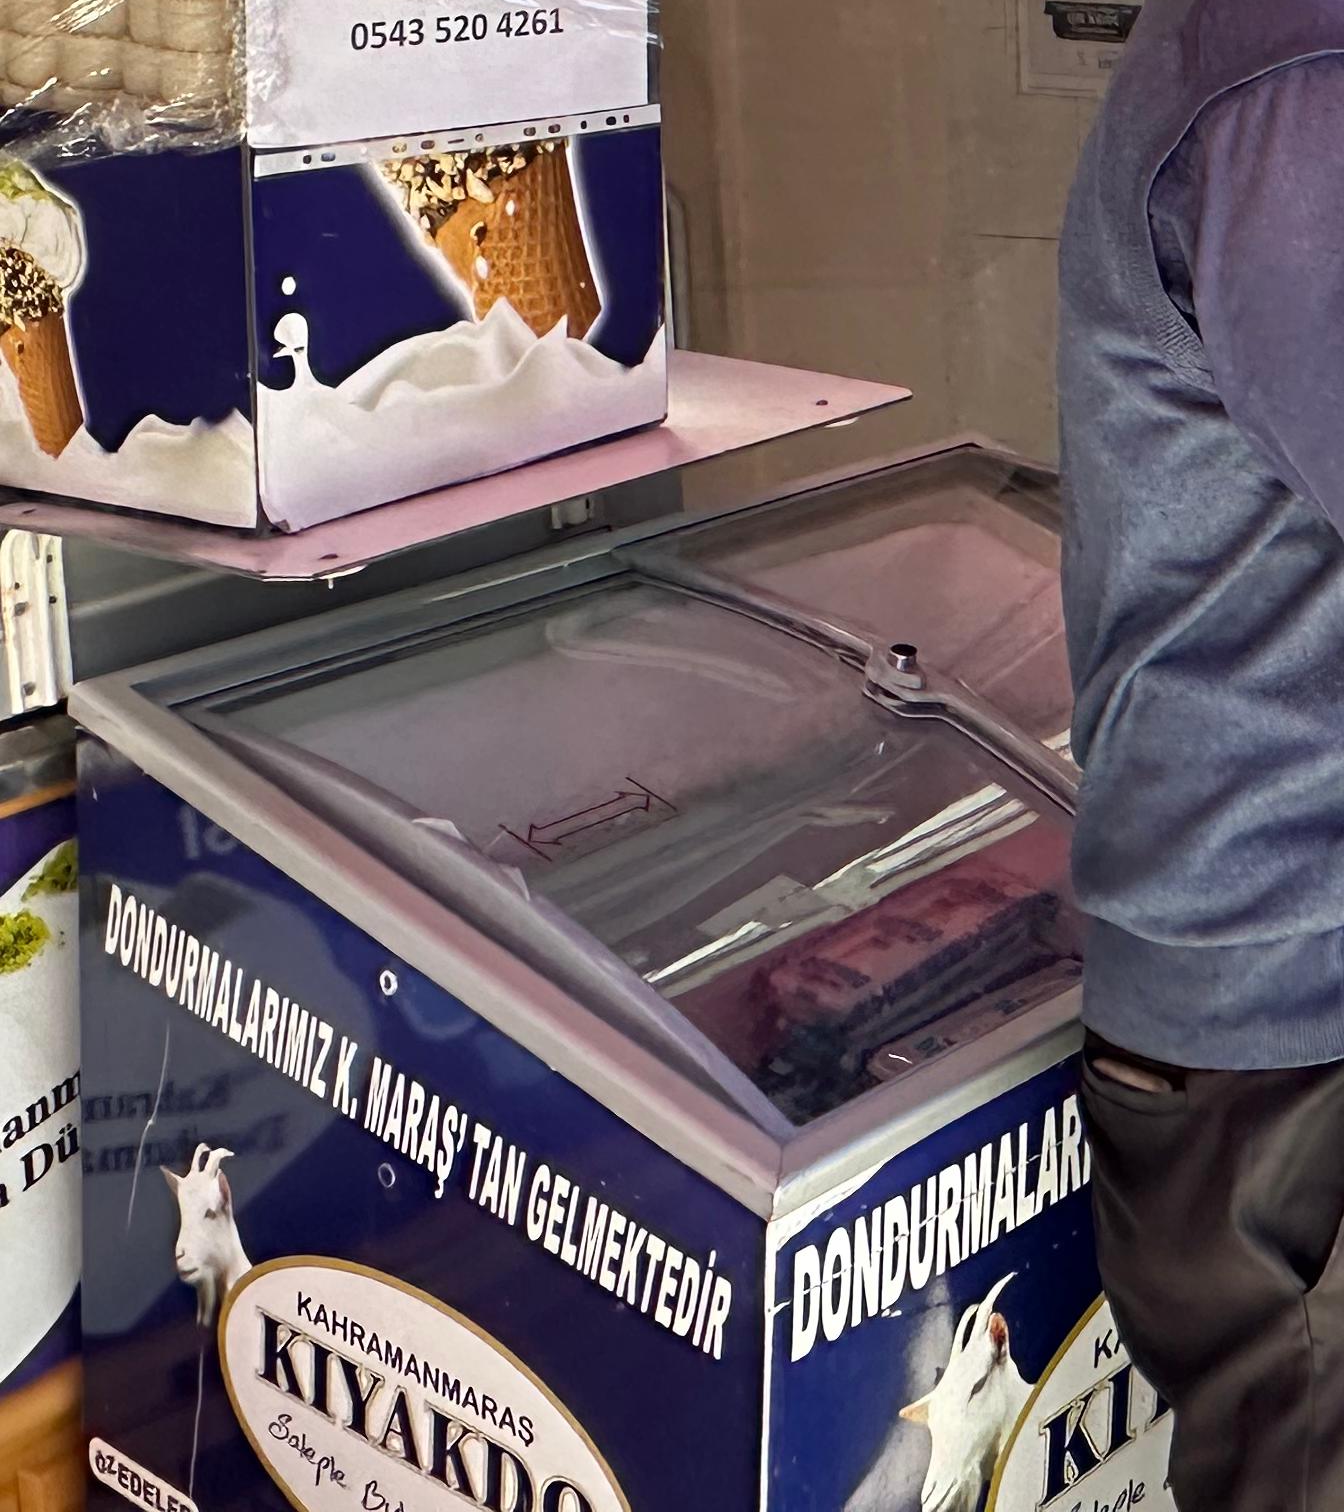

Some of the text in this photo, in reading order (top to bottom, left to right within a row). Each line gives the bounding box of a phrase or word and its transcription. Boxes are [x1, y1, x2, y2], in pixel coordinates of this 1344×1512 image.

[350, 7, 564, 52] 0543 520 4261
[105, 883, 334, 1100] DONDURMALARIMIZ
[331, 1039, 360, 1118] K.
[468, 1122, 518, 1228] TAN
[526, 1172, 734, 1360] GELMEKTEDİR
[296, 1291, 535, 1449] KAHRAMANMARAŞ
